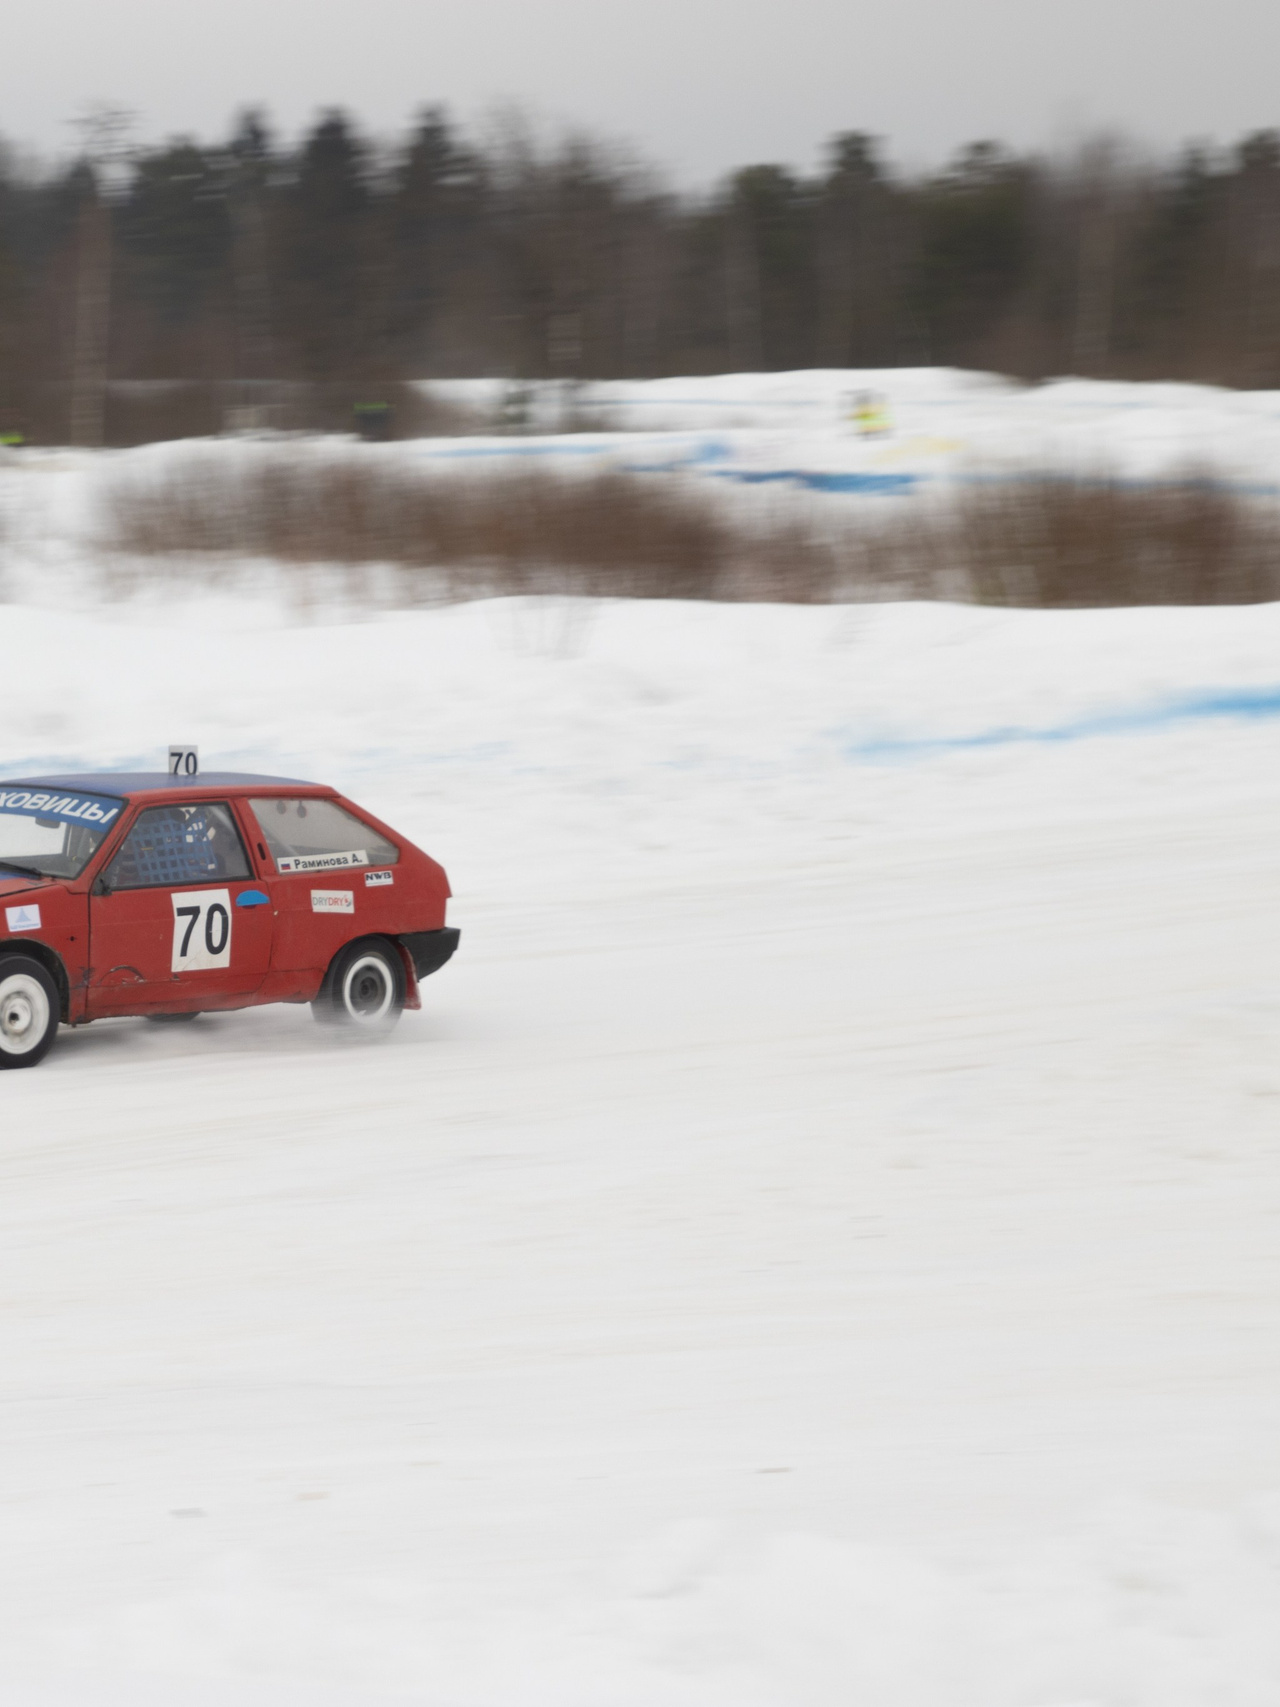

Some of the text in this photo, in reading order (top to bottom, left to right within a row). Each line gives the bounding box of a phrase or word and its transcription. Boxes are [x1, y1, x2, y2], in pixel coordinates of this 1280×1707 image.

[170, 752, 197, 775] 70
[293, 853, 363, 870] Раминова А.
[365, 871, 392, 881] NWB
[312, 896, 344, 907] DRYDRY
[176, 903, 229, 957] 70
